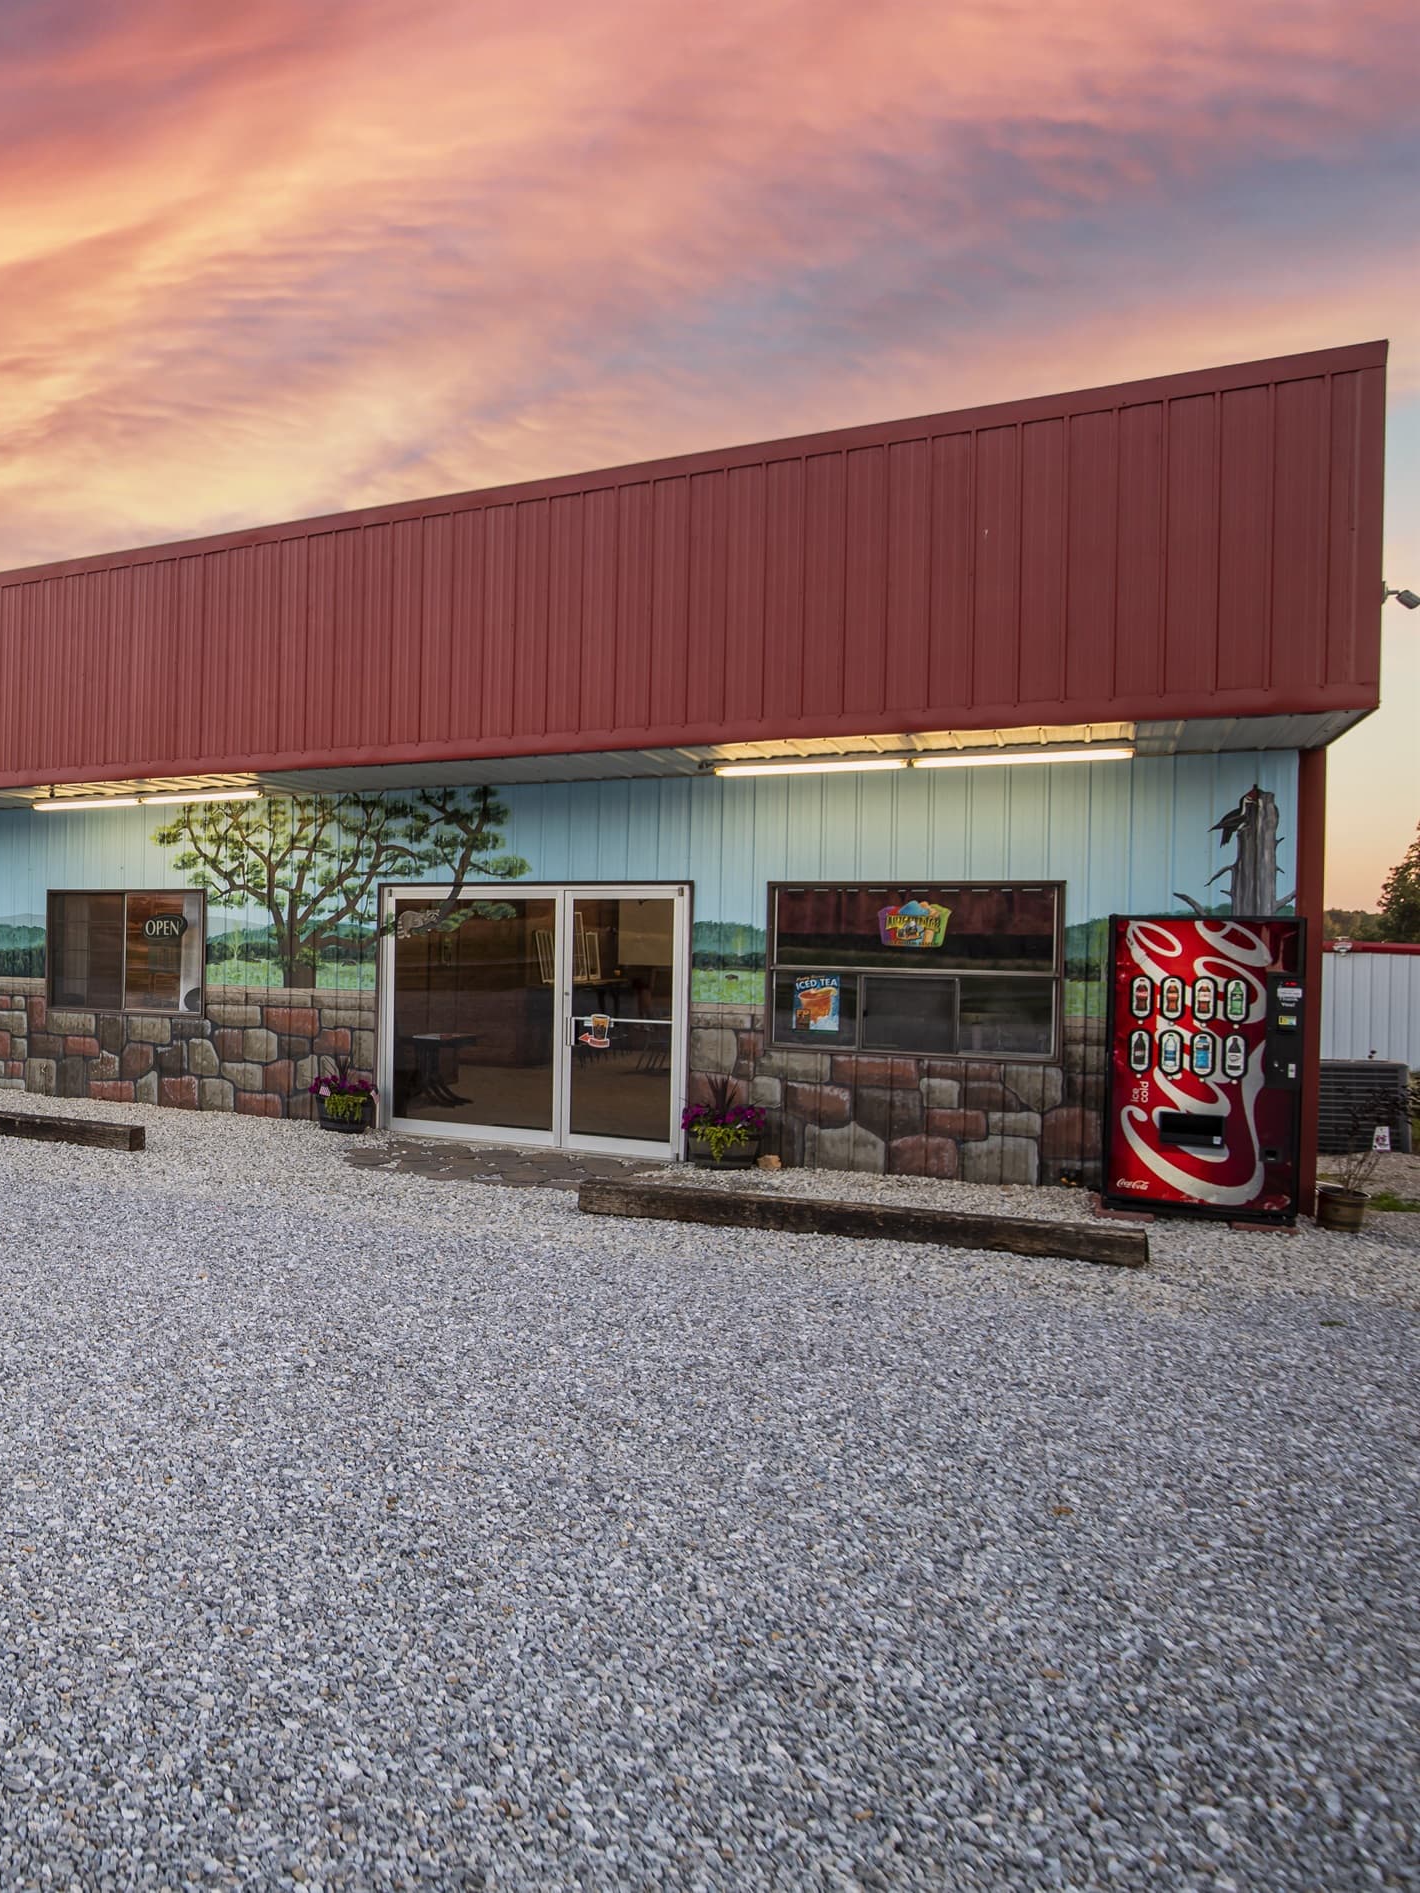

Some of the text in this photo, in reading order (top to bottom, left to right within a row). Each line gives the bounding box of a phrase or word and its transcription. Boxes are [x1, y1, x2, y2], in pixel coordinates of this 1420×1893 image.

[145, 919, 180, 936] OPEN
[795, 980, 817, 990] ICED
[820, 978, 838, 987] TEA
[1131, 1088, 1140, 1102] ice
[1140, 1081, 1149, 1103] cold
